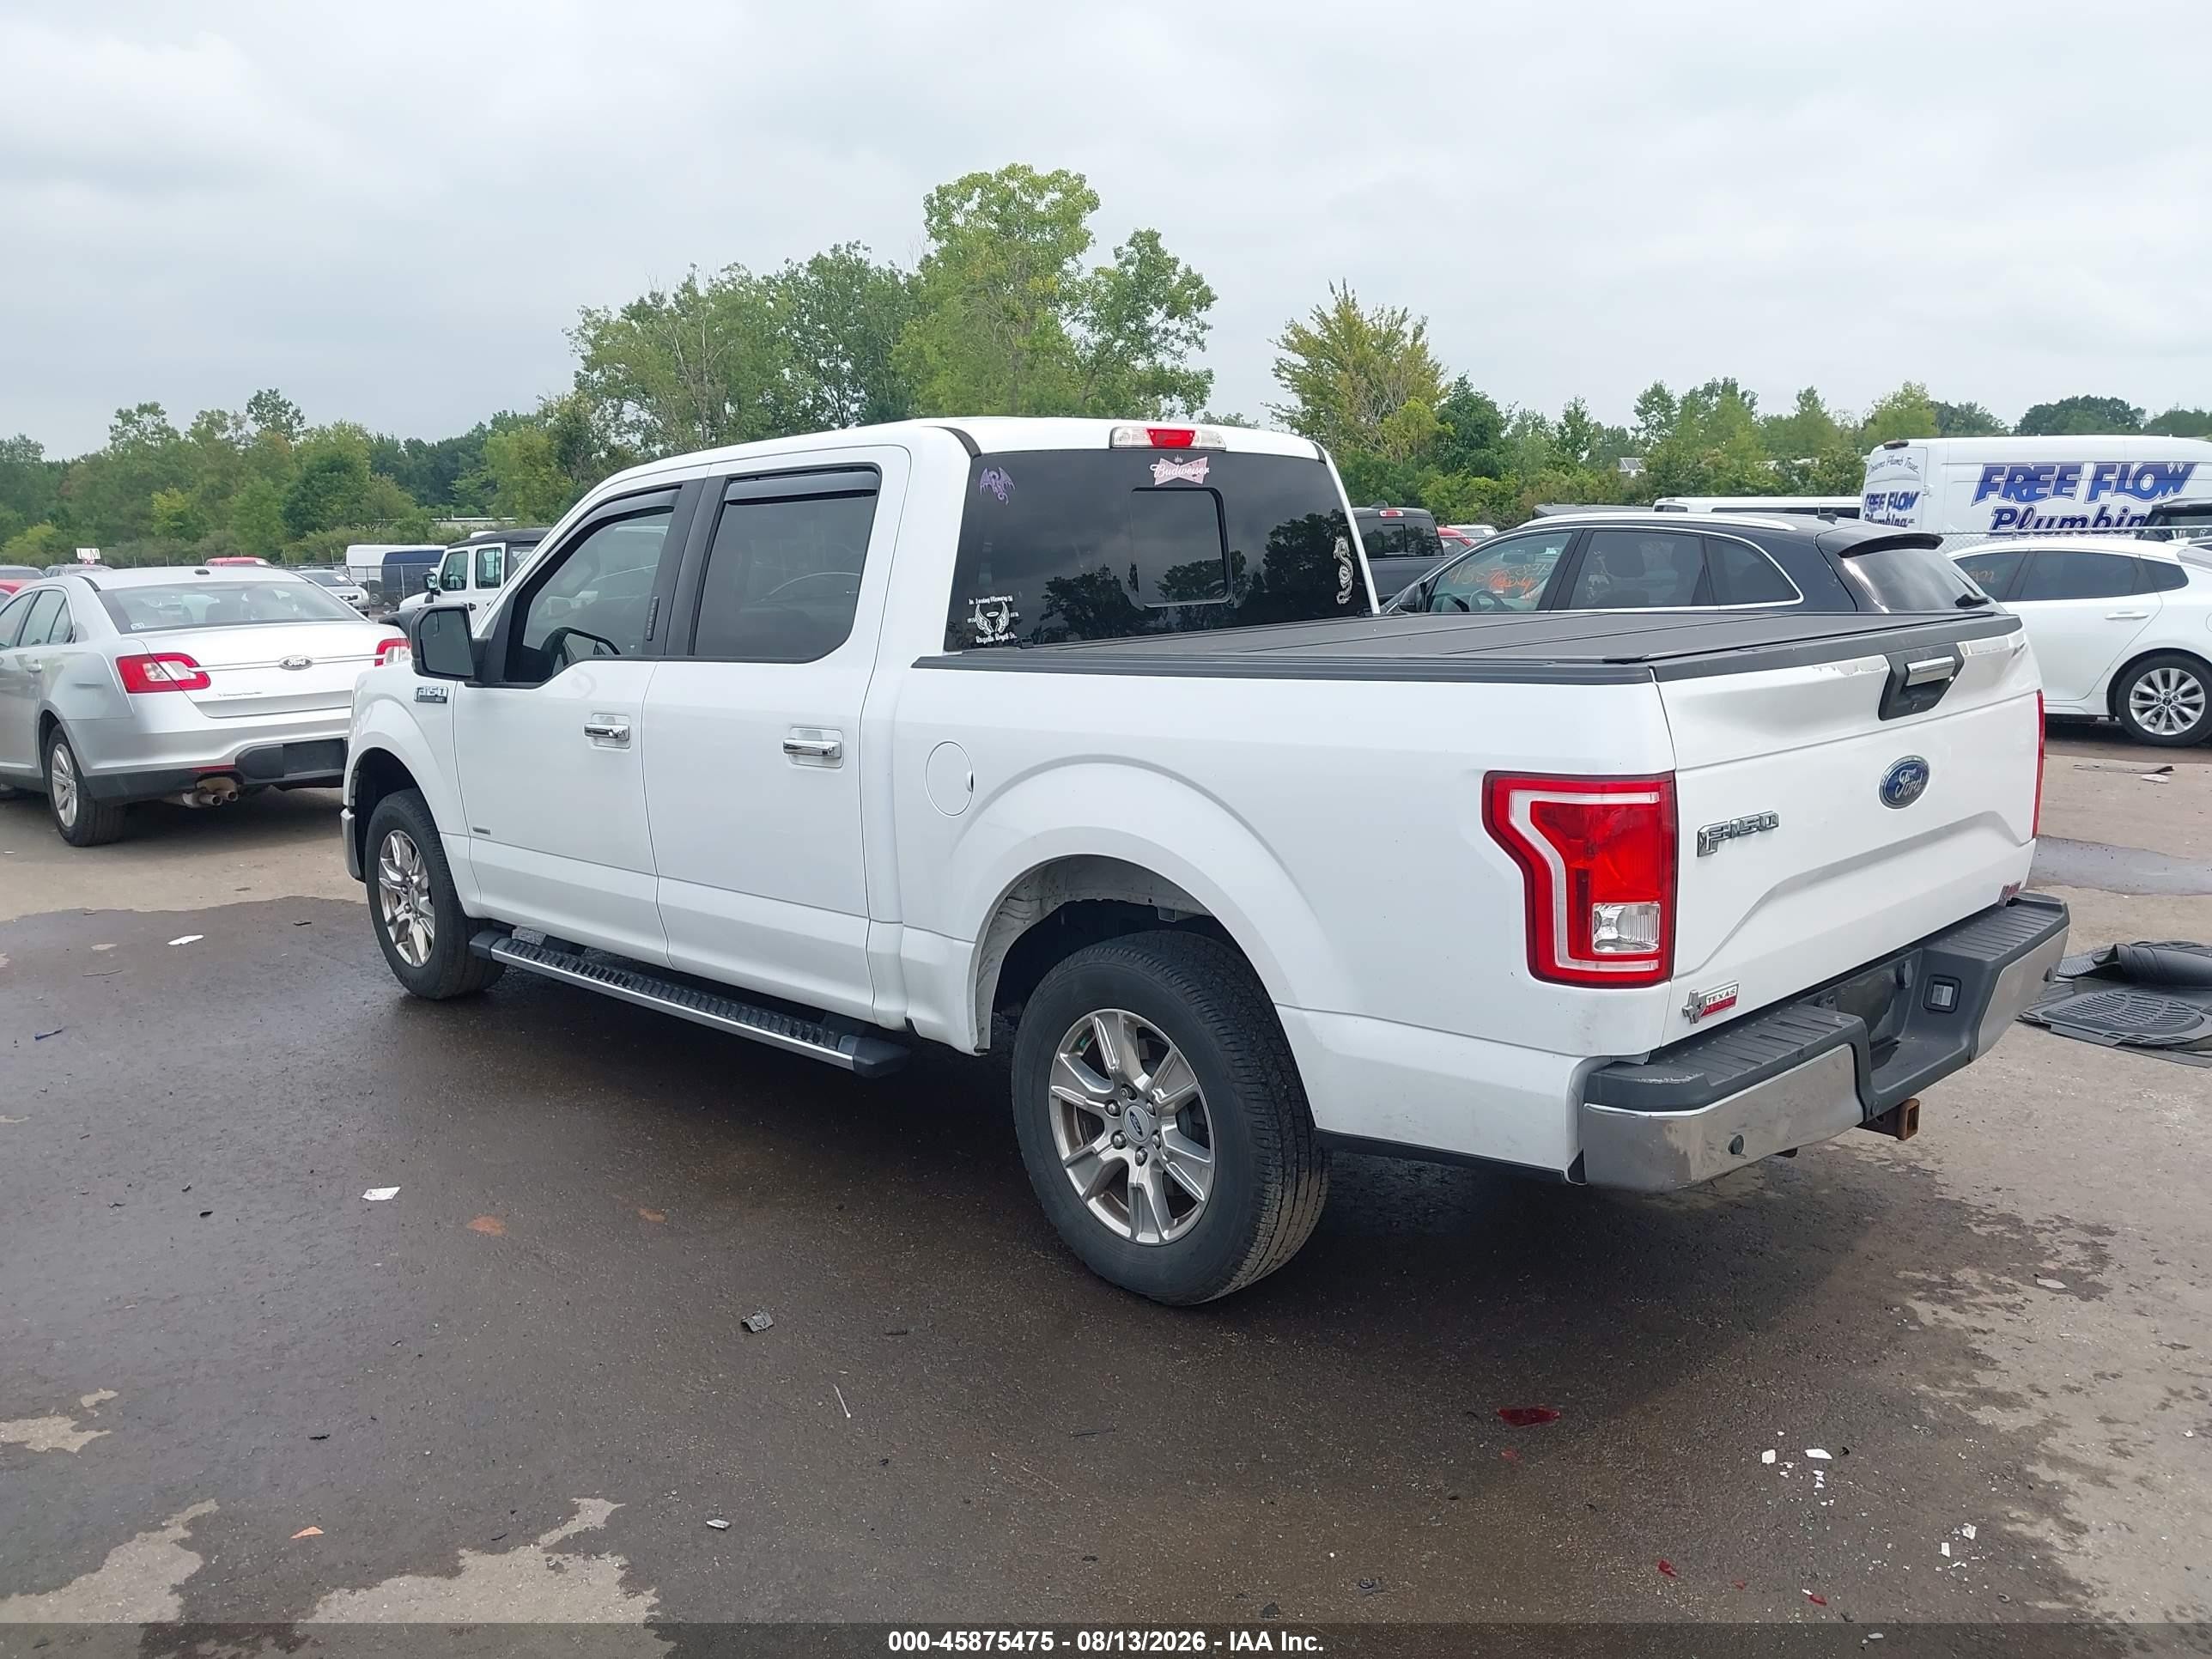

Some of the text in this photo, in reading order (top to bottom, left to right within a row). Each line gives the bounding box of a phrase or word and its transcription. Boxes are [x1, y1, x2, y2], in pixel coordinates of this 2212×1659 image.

[1150, 464, 1210, 479] Budweiser
[1972, 461, 2198, 507] FREE FLOW
[1863, 490, 1922, 513] FREE FLOW
[1986, 504, 2148, 538] Plumbin
[1707, 987, 1736, 1004] TEXAS
